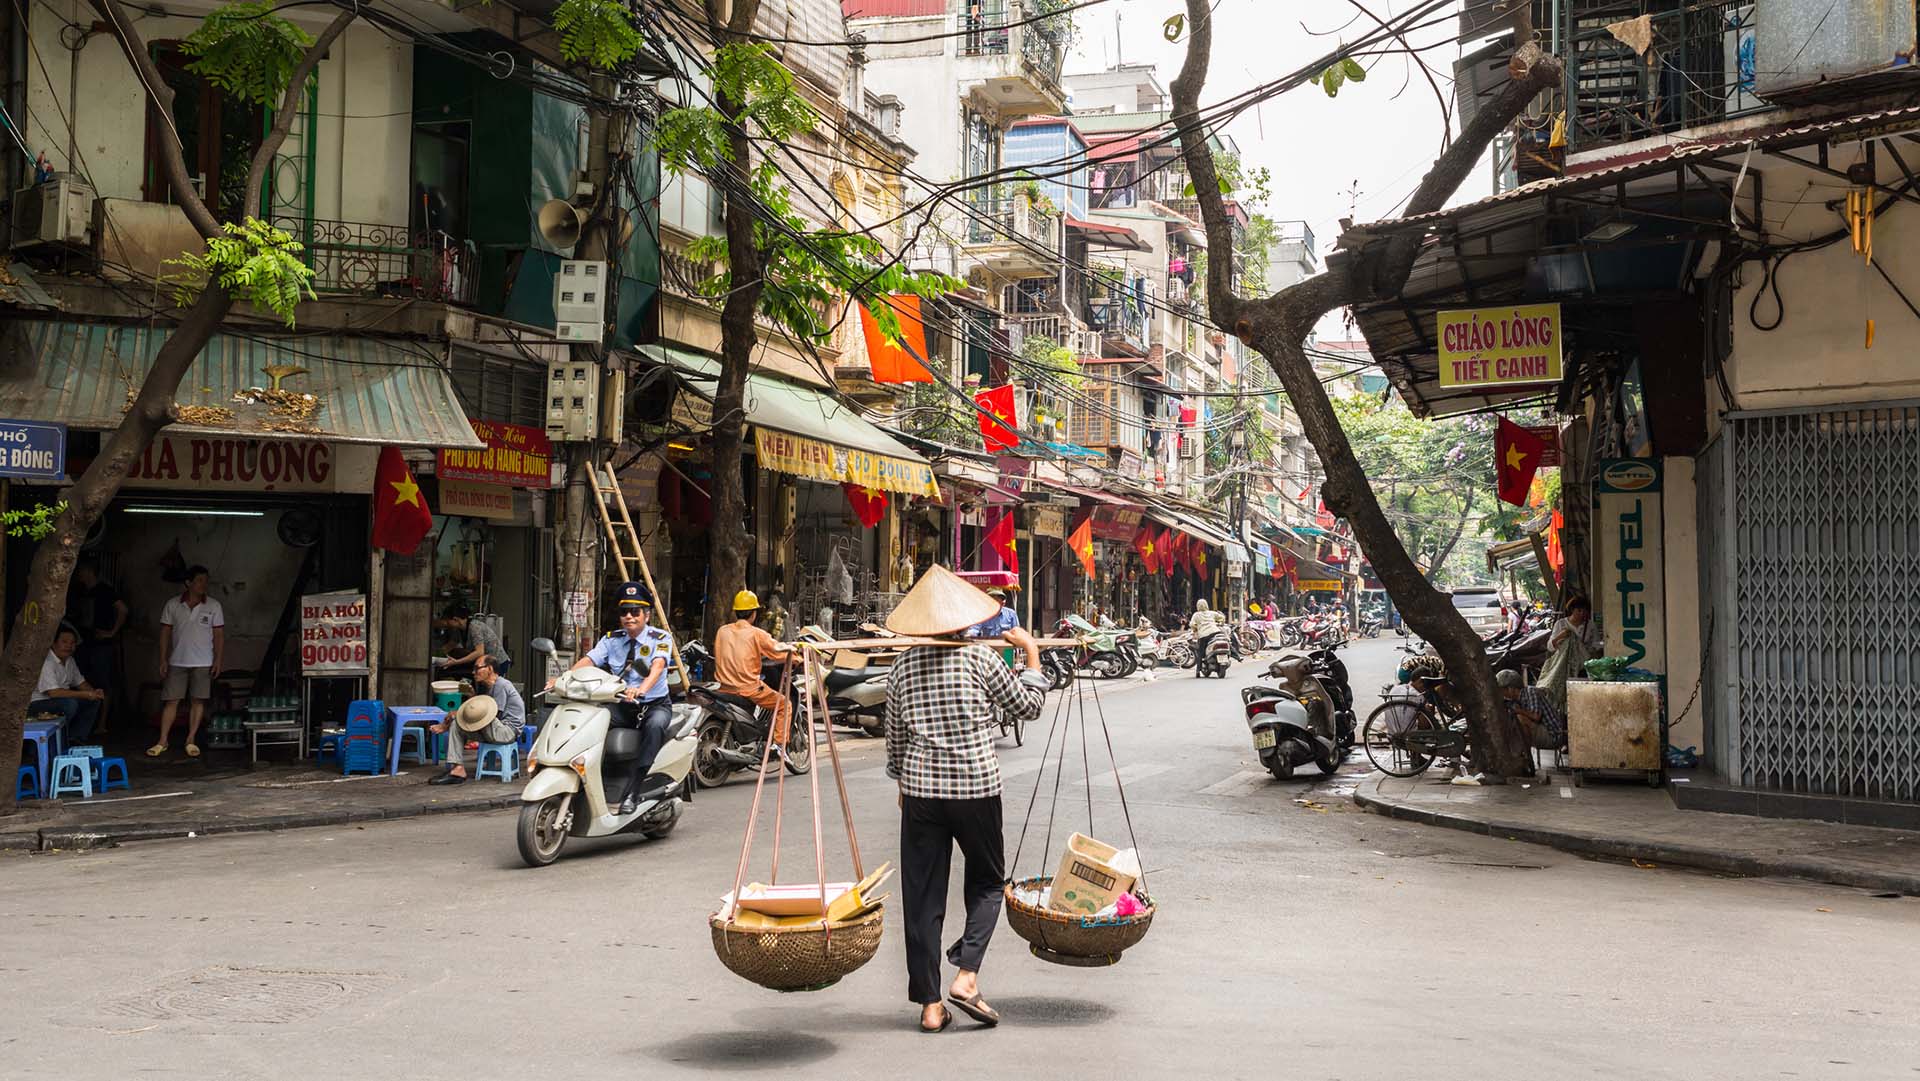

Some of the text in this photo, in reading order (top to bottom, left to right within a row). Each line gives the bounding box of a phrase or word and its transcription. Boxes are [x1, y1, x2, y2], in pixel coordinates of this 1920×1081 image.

[1443, 311, 1553, 352] CHÁO LÒNG
[1452, 353, 1547, 380] TIẾT CANH
[11, 444, 54, 470] ĐỒNG
[496, 444, 521, 473] HÀNG
[303, 606, 333, 619] BIA
[303, 622, 361, 642] HÀ NỘI
[303, 644, 351, 666] 9000
